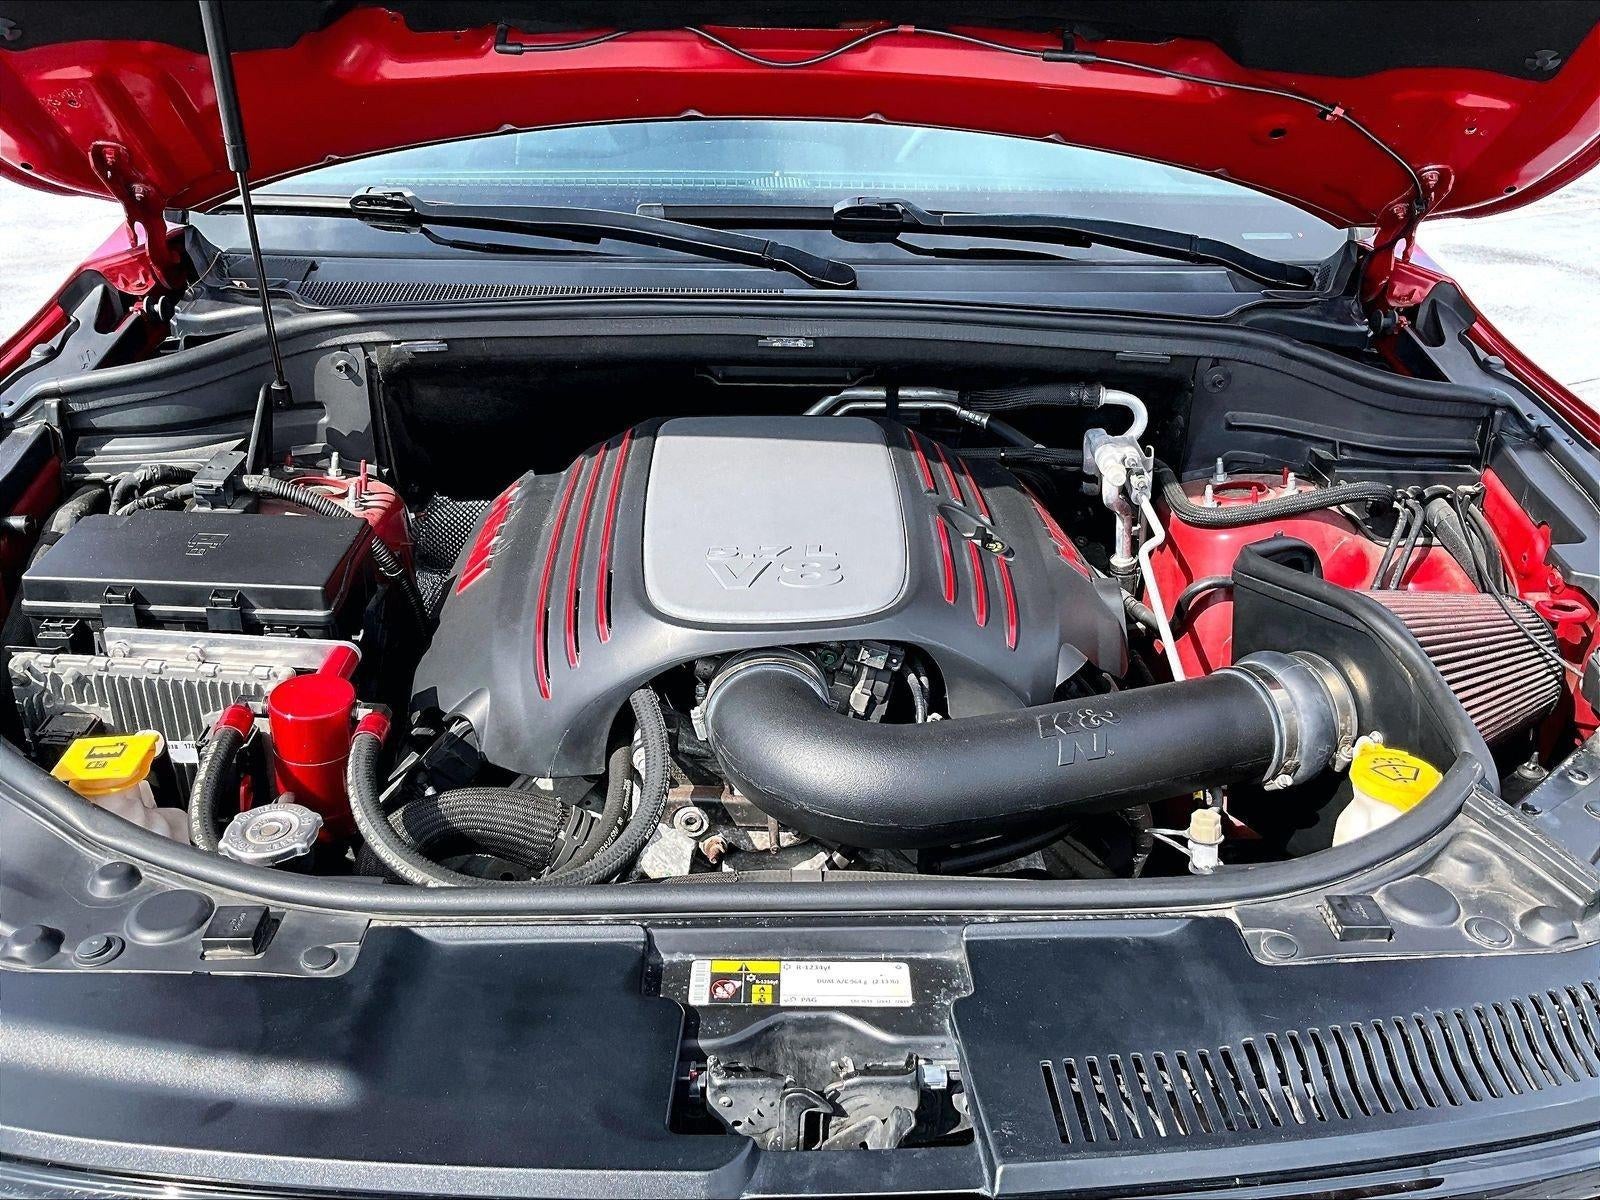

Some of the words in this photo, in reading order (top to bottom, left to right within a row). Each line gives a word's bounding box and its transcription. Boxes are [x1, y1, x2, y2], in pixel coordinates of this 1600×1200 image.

[704, 543, 838, 559] 5.7L
[704, 559, 845, 590] V8
[644, 823, 656, 840] USA
